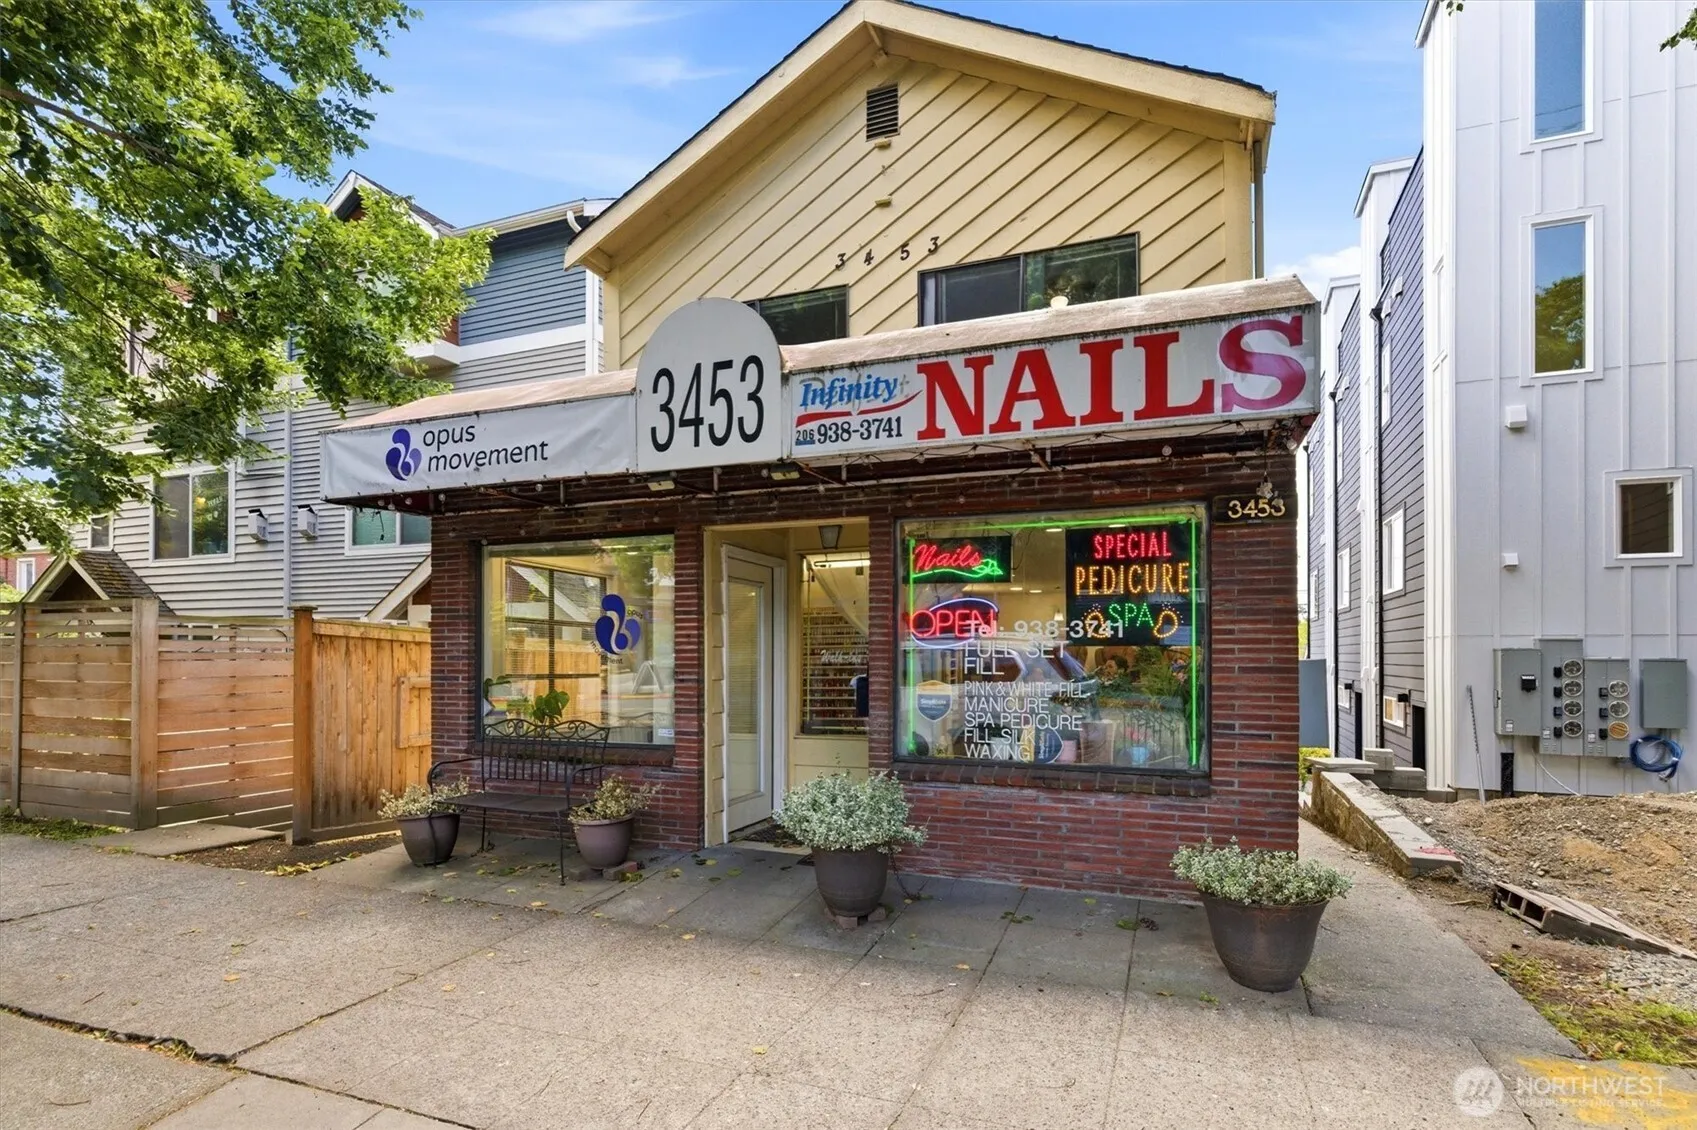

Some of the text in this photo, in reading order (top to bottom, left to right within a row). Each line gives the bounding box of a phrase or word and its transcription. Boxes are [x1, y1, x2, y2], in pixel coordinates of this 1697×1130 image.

[917, 315, 1307, 440] NAILS
[650, 354, 765, 453] 3453
[799, 374, 899, 410] Infinity
[422, 425, 476, 452] opus
[796, 416, 903, 445] 206 938-3741
[427, 441, 549, 473] movement
[1228, 498, 1286, 519] 3453
[1094, 531, 1172, 559] SPECIAL
[914, 544, 982, 573] Nails
[1075, 562, 1190, 596] PEDICURE
[909, 608, 994, 638] OPEN
[1108, 602, 1154, 627] SPA
[1013, 620, 1125, 639] 938-3741
[964, 639, 1070, 659] FULL SET
[963, 657, 1005, 675] FILL
[1058, 682, 1085, 698] FILL
[964, 697, 1050, 714] MANICURE
[964, 712, 1083, 731] SPA PEDICURE
[964, 728, 992, 744] FILL
[1001, 729, 1036, 746] SILK
[964, 743, 1031, 762] WAXING
